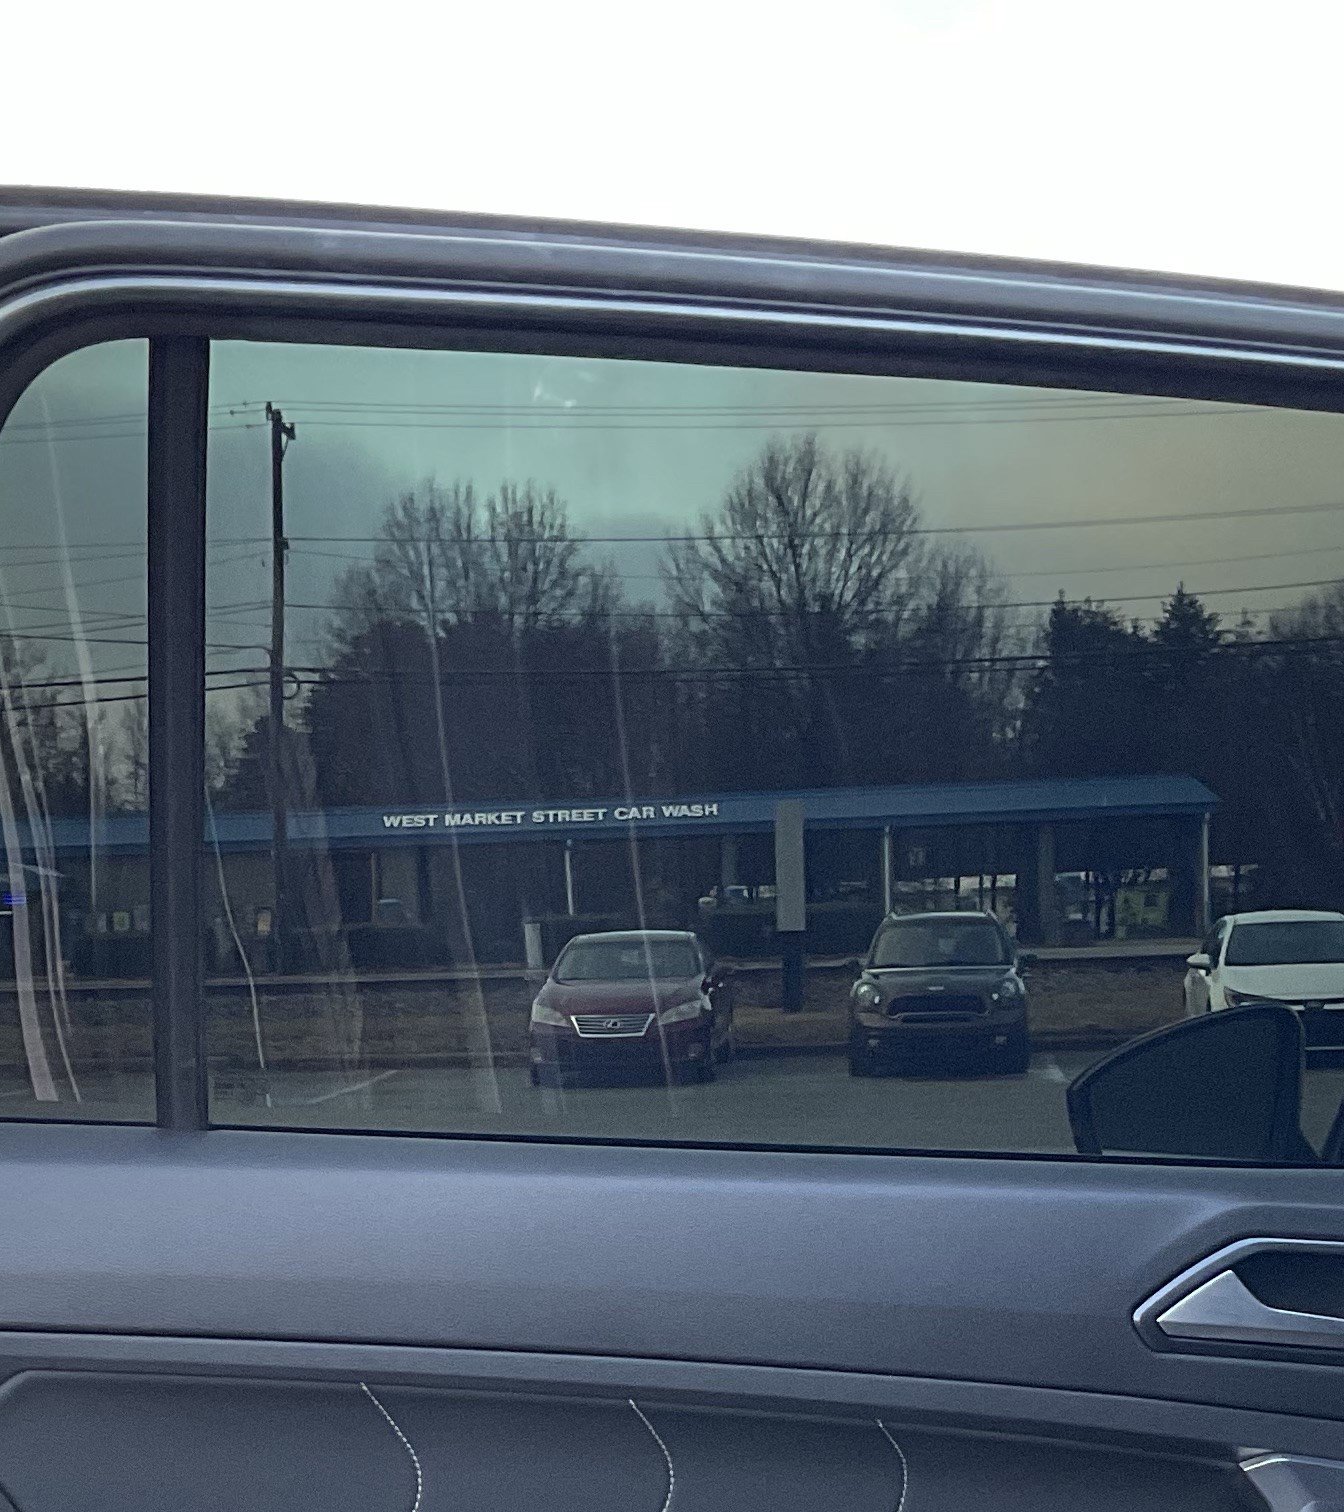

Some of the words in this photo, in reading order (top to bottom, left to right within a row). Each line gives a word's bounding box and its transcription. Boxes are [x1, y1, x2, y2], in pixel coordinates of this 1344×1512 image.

[383, 814, 438, 827] WEST
[444, 811, 525, 826] MARKET
[532, 808, 607, 823] STREET
[613, 806, 656, 820] CAR
[661, 803, 718, 817] WASH
